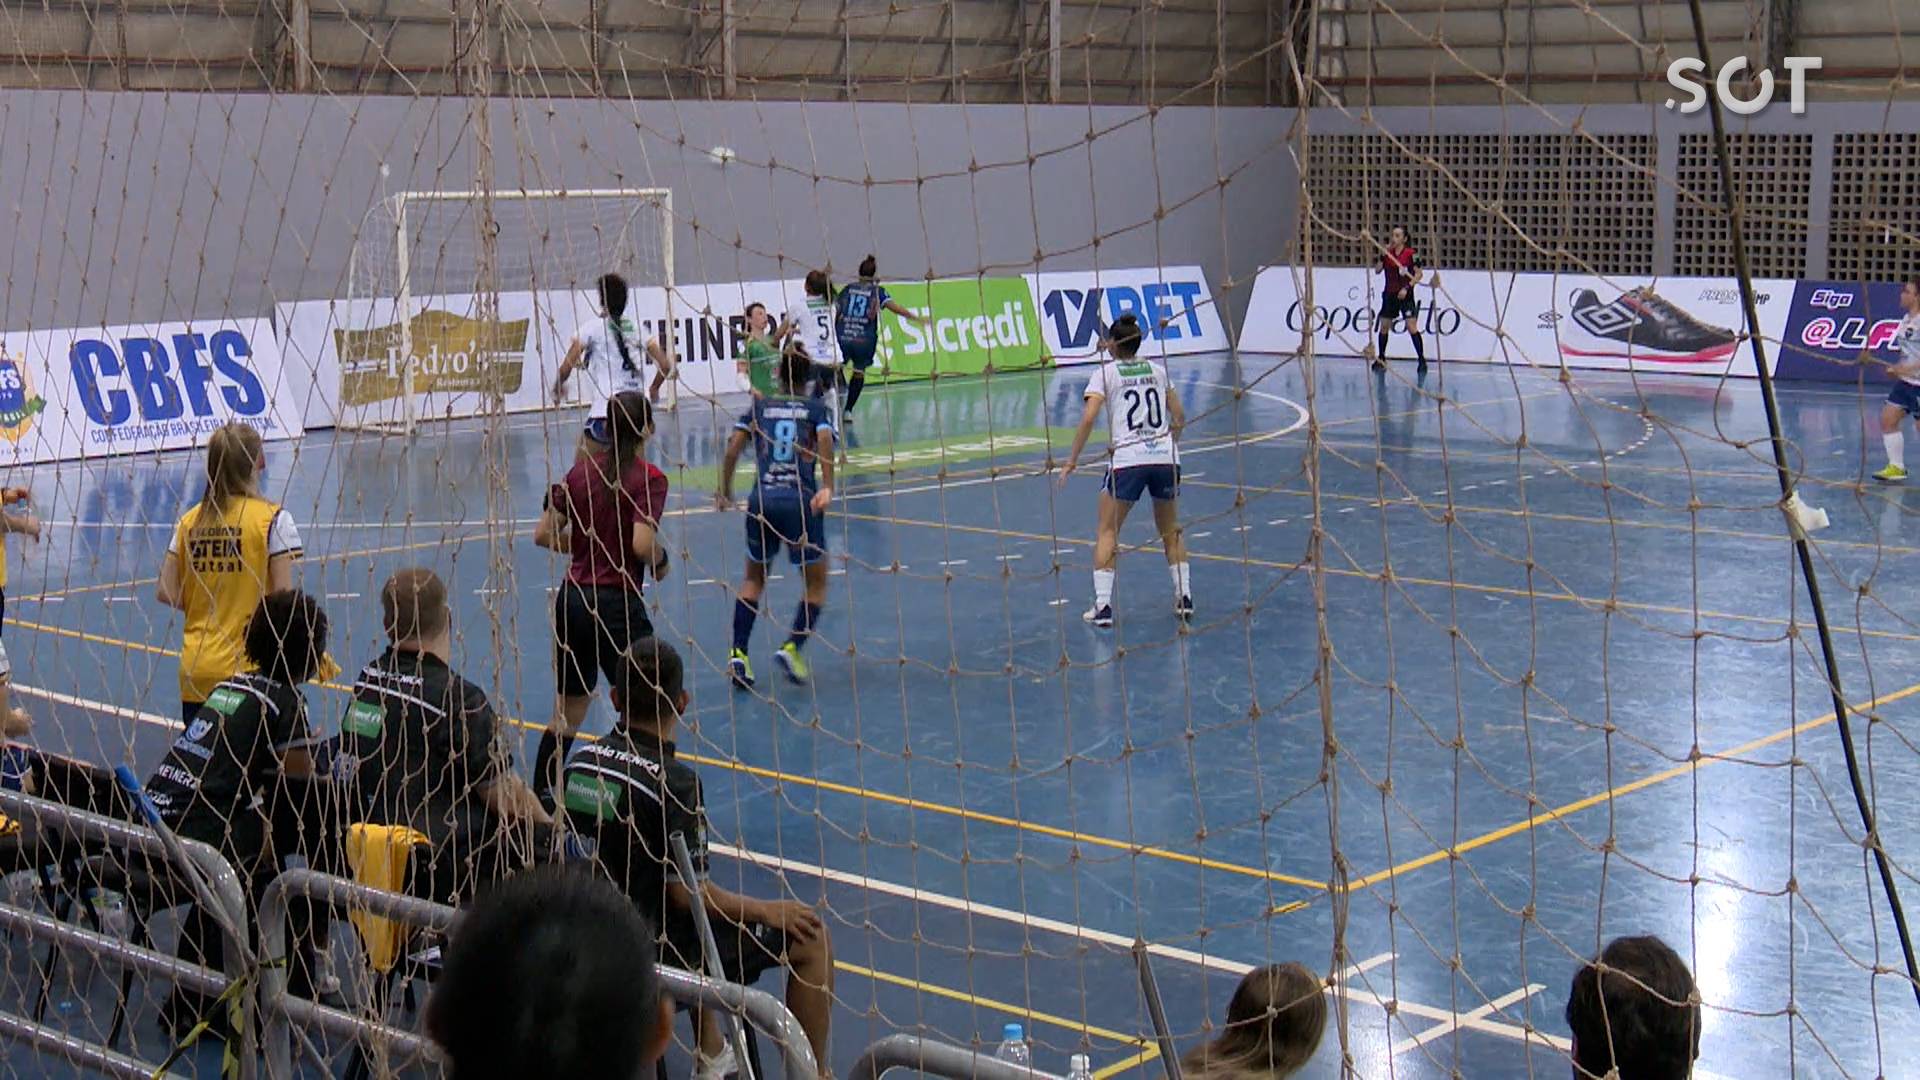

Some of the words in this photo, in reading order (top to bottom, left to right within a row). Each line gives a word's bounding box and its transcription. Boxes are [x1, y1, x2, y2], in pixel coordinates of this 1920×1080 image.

[848, 294, 867, 317] 13
[1043, 282, 1202, 348] 1XBET
[1810, 290, 1853, 310] Siga
[817, 315, 829, 340] 5
[897, 301, 1029, 354] Sicredi
[69, 329, 266, 426] CBFS
[1124, 387, 1162, 431] 20
[773, 419, 797, 462] 8
